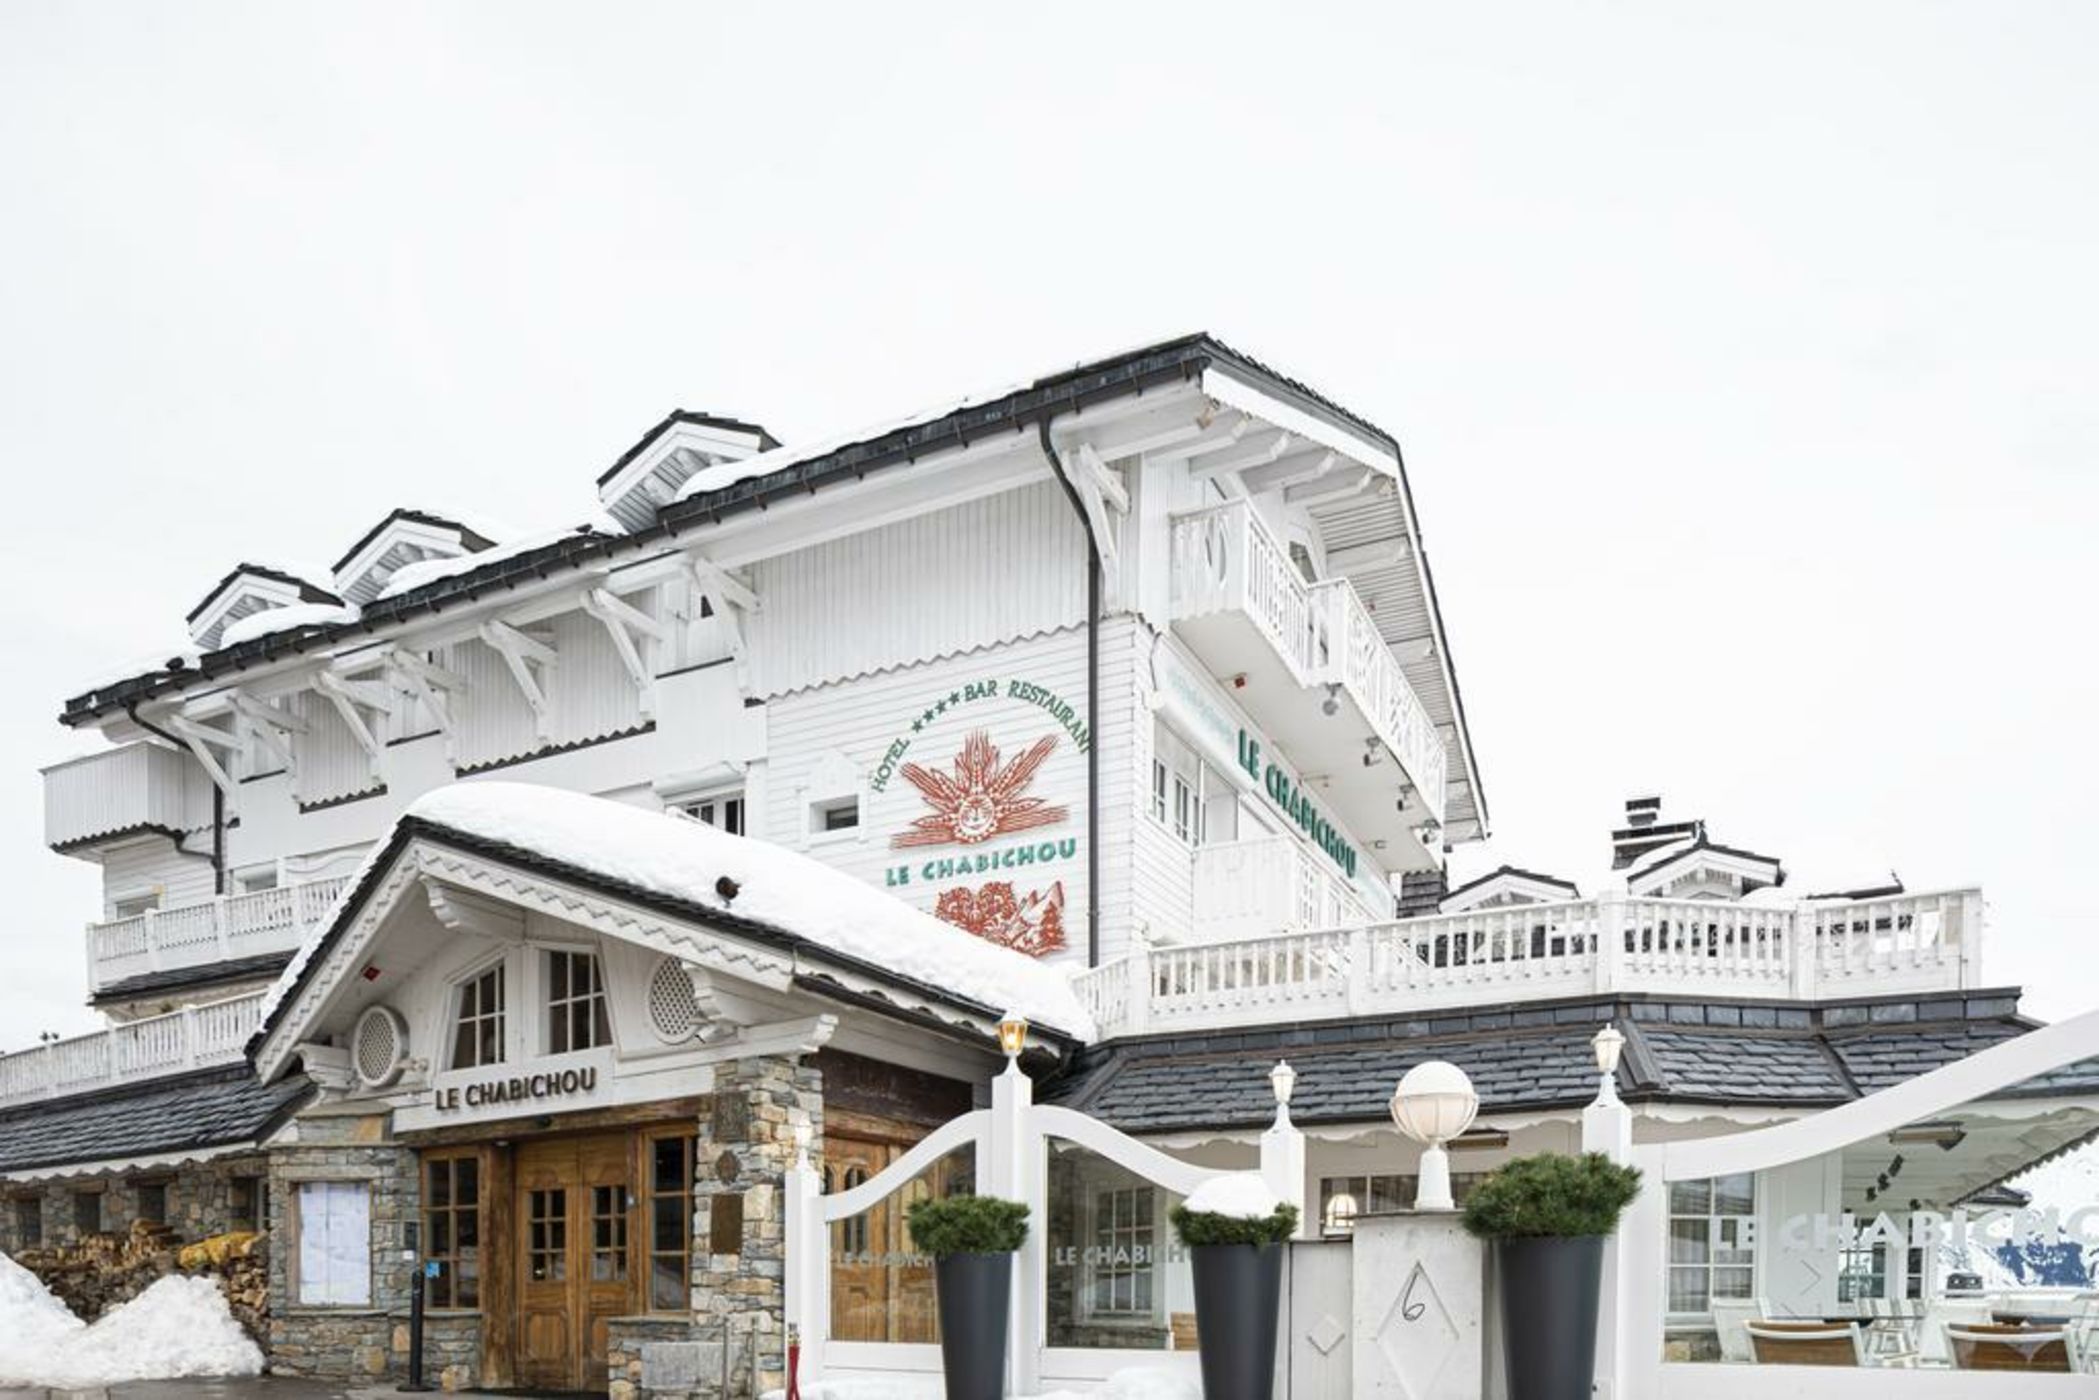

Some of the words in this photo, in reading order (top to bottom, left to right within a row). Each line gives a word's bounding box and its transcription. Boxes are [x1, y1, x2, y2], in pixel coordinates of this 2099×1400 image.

[870, 737, 911, 794] HOTEL
[964, 680, 998, 701] BAR
[1238, 727, 1260, 782] LE
[1265, 764, 1356, 880] CHABICHOU
[885, 865, 909, 887] LE
[921, 837, 1077, 880] CHABICHOU
[435, 1088, 460, 1111] LE
[465, 1066, 597, 1107] CHABICHOU
[1055, 1246, 1078, 1266] LE
[1402, 1270, 1426, 1321] 6
